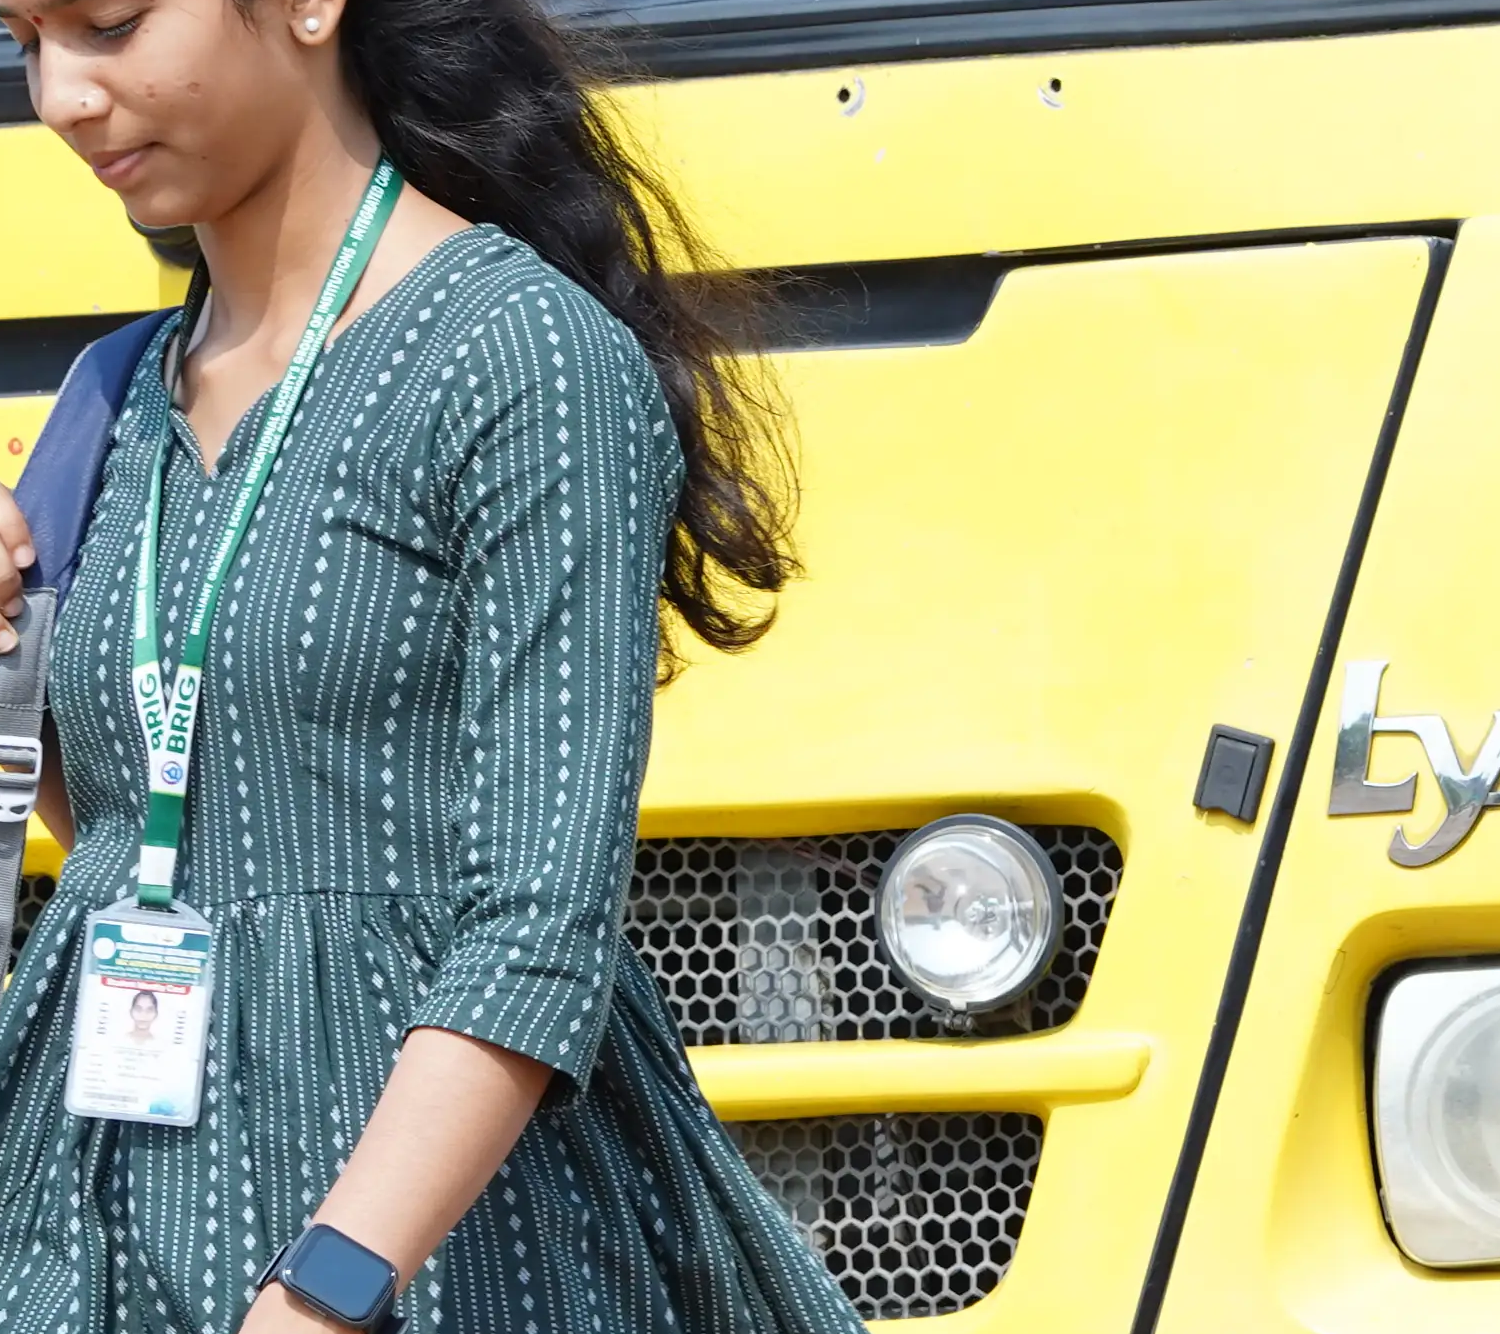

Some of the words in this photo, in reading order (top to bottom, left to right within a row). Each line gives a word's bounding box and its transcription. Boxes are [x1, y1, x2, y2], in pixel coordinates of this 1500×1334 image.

[317, 246, 357, 315] INSTITUTIONS
[308, 307, 327, 328] OF
[292, 326, 316, 365] GROUP
[248, 415, 282, 484] EDUCATIONAL
[229, 485, 252, 527] SCHOOL
[190, 581, 213, 635] BRILLIANT
[166, 675, 196, 754] BRIG
